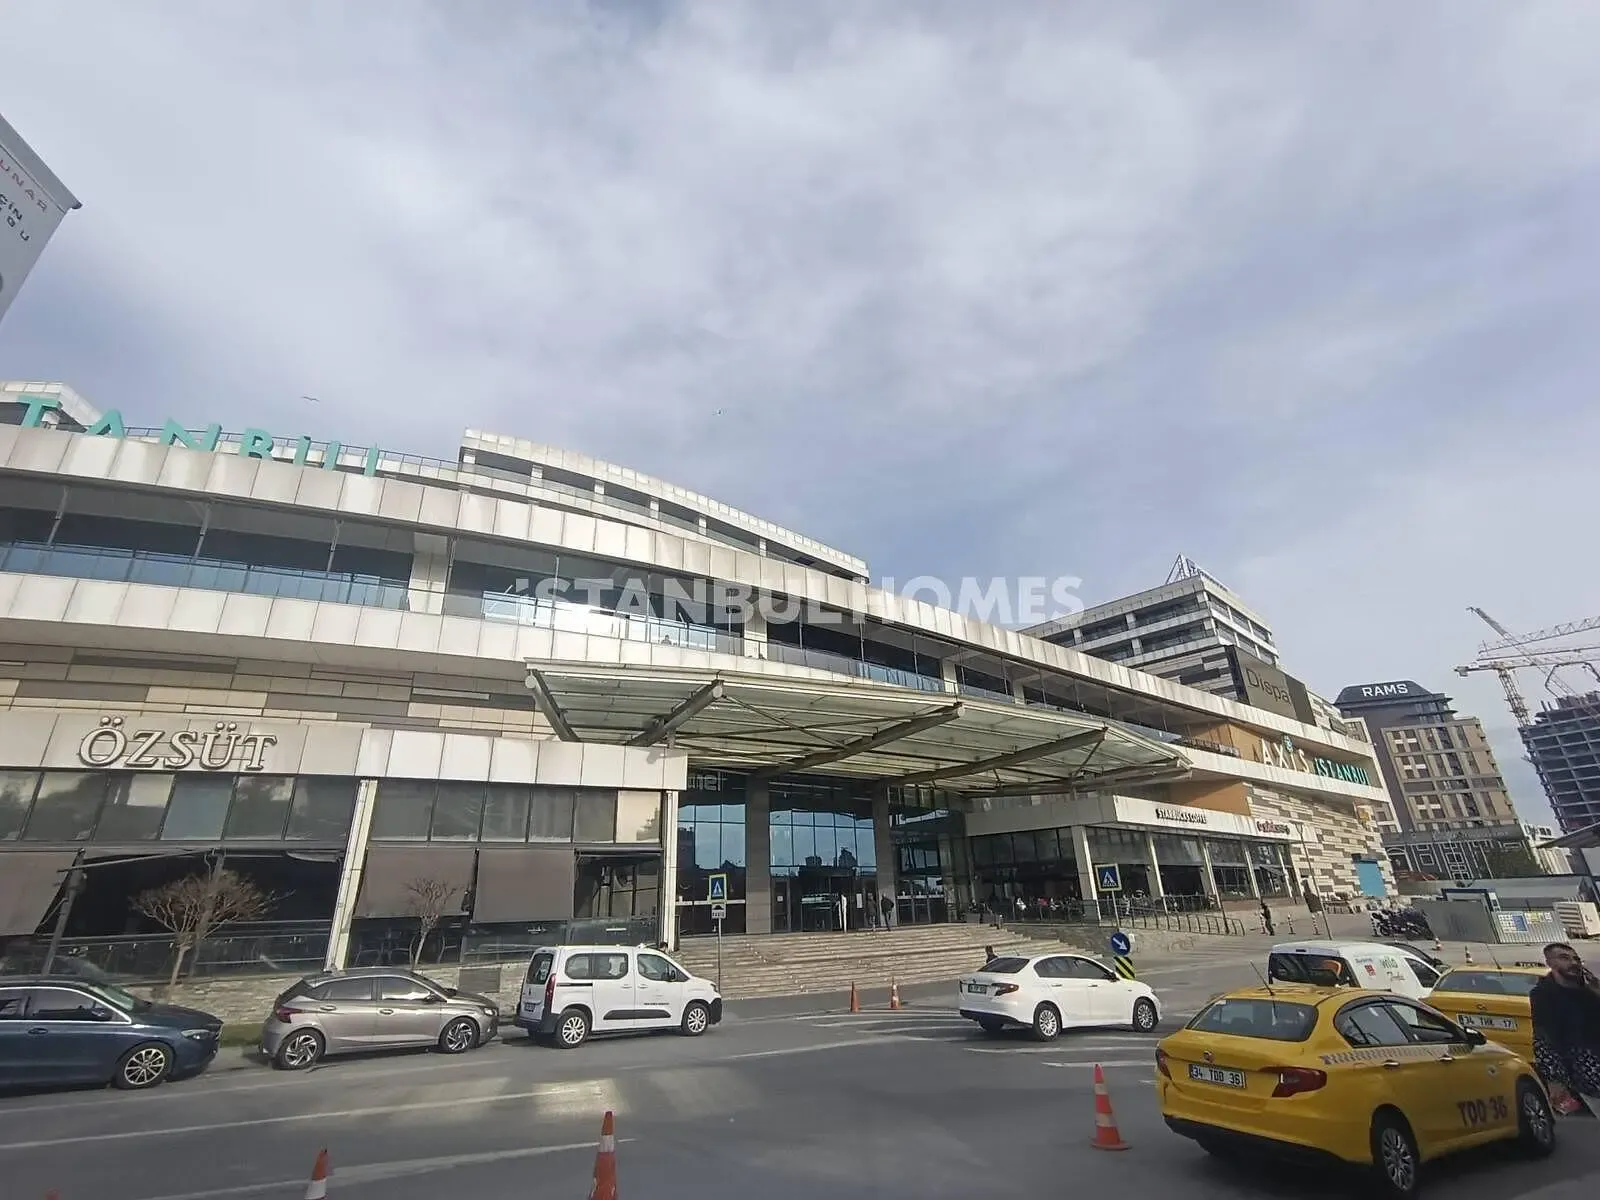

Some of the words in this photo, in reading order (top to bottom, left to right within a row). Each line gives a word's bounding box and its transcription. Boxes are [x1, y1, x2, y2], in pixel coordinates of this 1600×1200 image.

[1362, 684, 1408, 697] RAMS
[79, 716, 278, 771] ÖZSÜT
[1192, 1066, 1203, 1078] 34
[1229, 1072, 1241, 1085] 36
